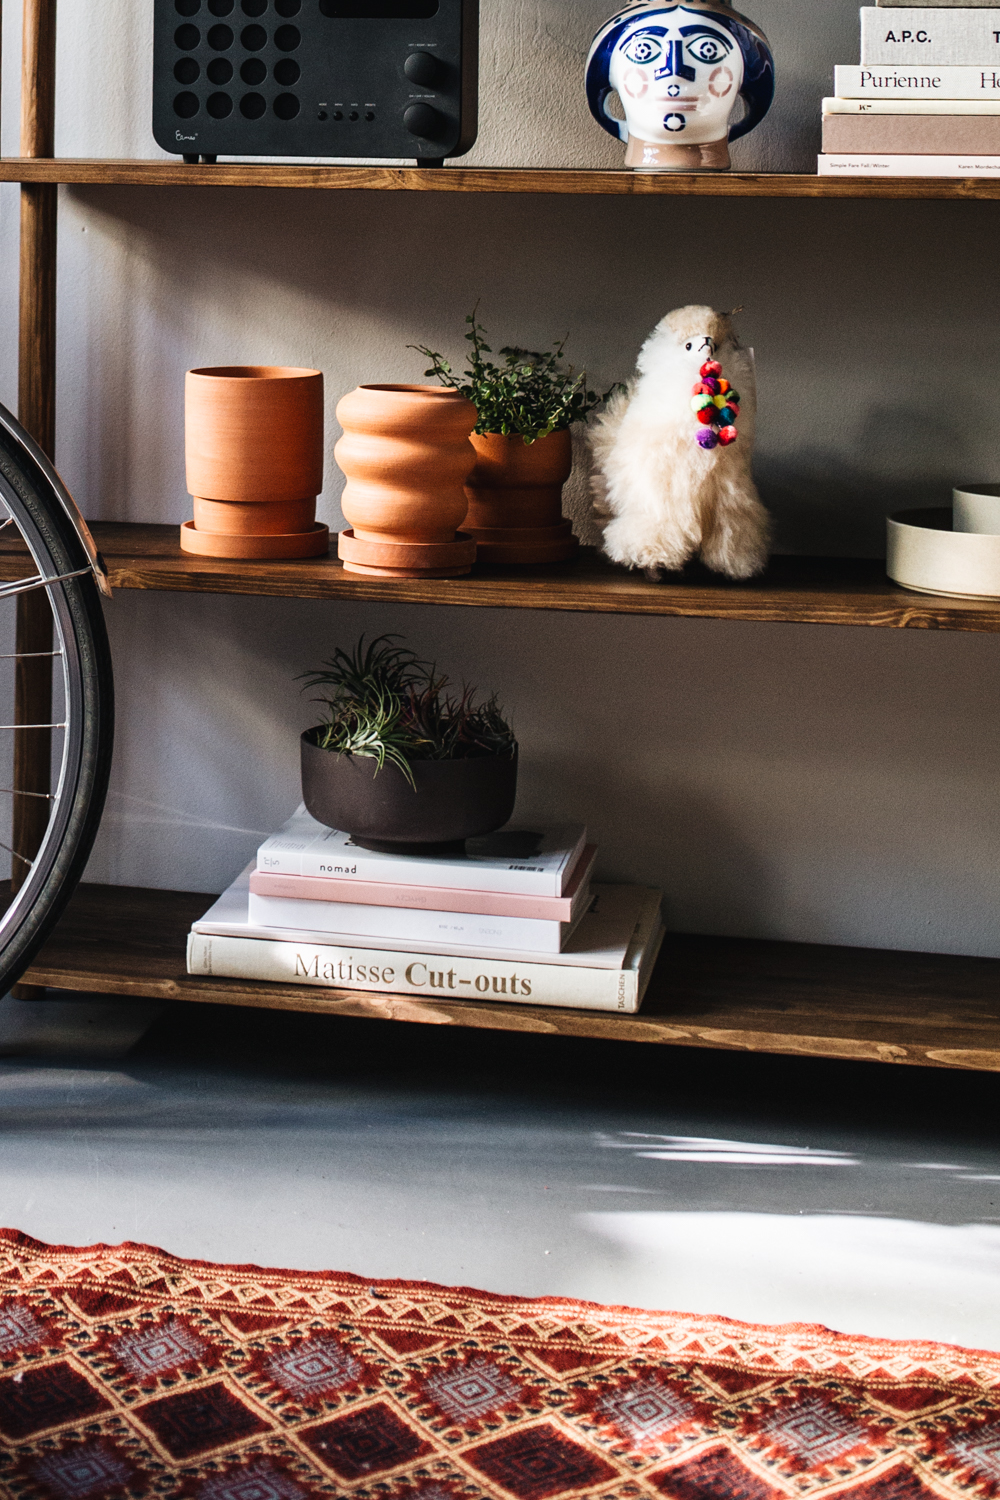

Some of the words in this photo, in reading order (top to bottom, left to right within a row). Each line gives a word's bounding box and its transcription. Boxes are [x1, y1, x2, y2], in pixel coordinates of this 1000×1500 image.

[885, 30, 931, 43] A.P.C.
[860, 71, 941, 88] Purienne
[319, 864, 357, 874] nomad
[294, 953, 395, 984] Matisse
[405, 962, 532, 996] Cut-outs
[617, 973, 626, 1009] TASCHEN
